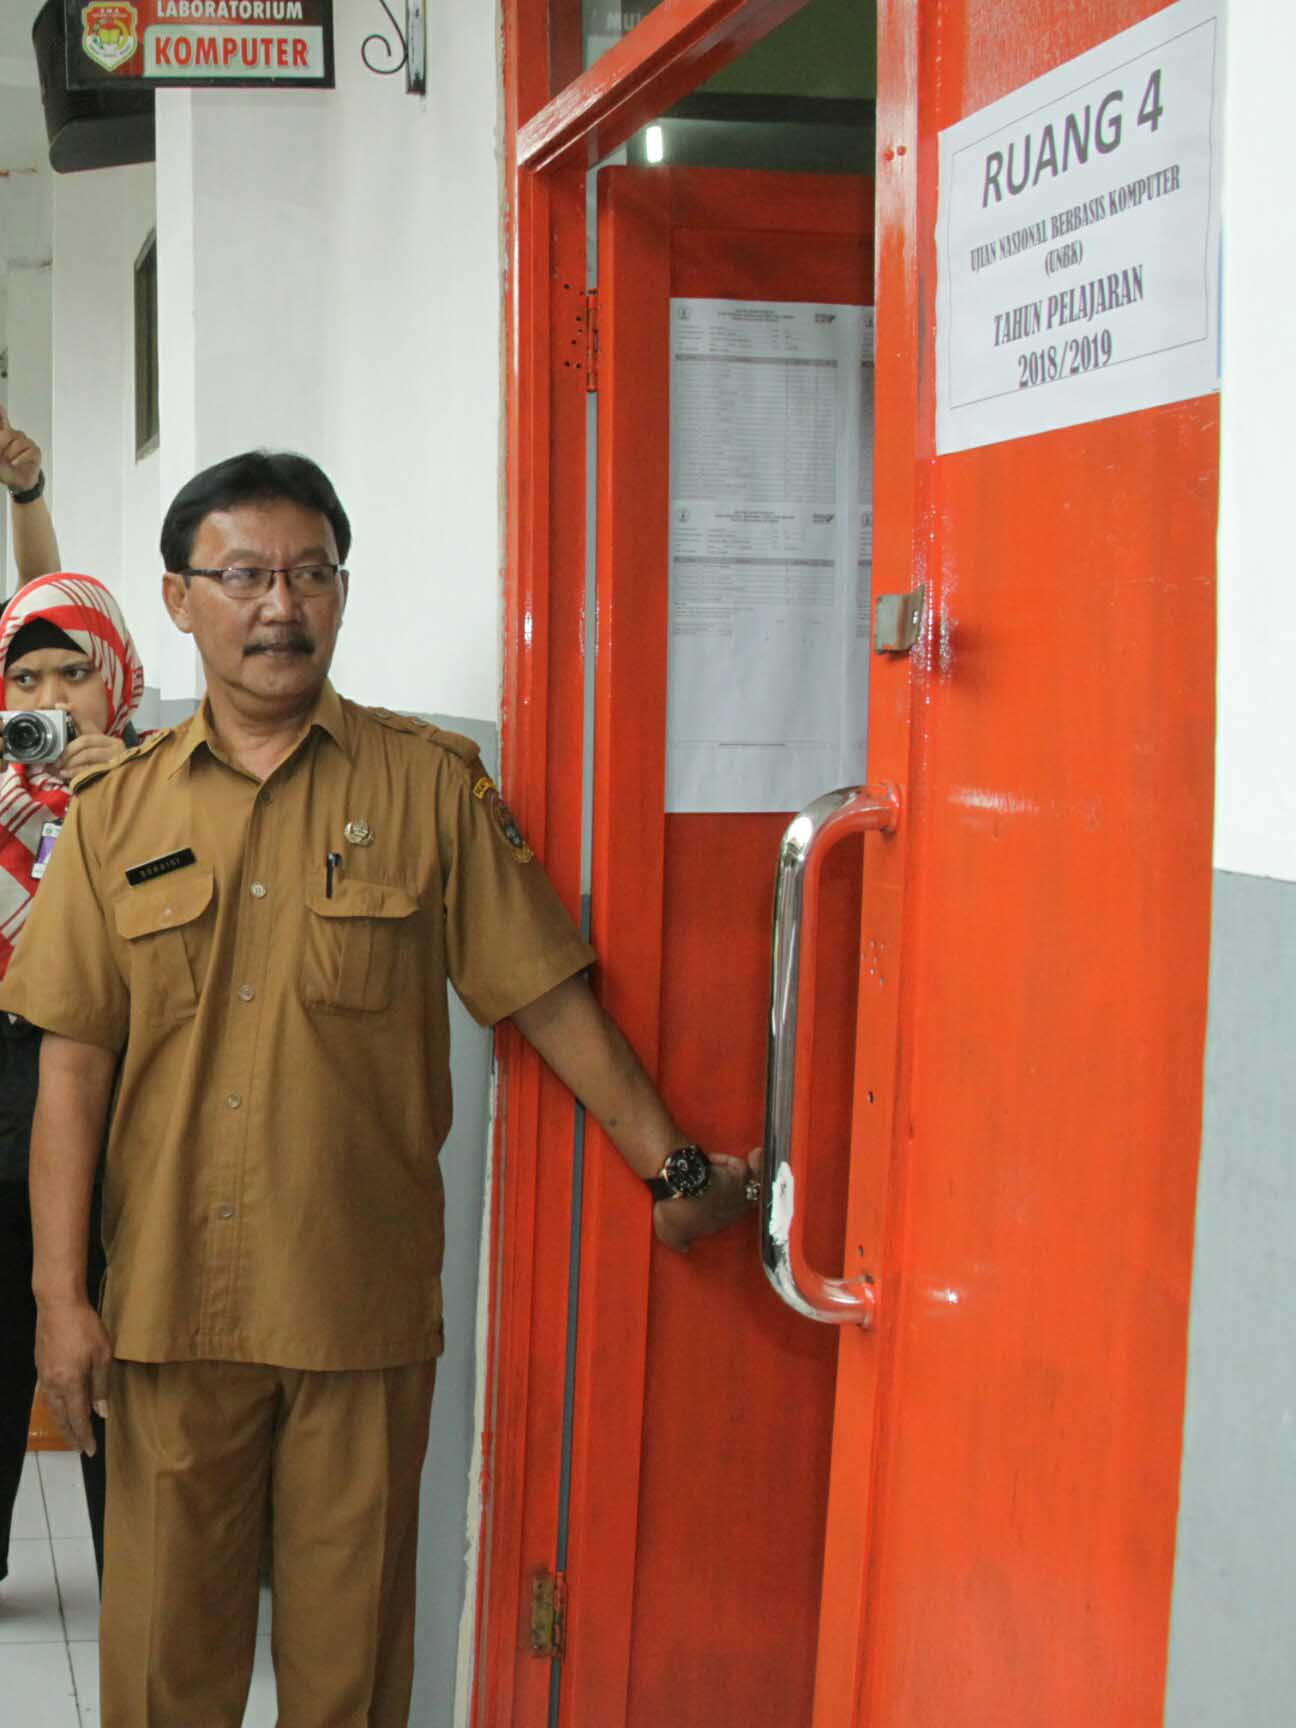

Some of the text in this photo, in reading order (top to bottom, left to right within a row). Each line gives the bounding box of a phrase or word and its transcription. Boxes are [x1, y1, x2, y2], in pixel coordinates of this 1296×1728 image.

[157, 1, 303, 19] LABORATORIUM
[155, 36, 308, 66] KOMPUTER
[982, 68, 1163, 209] RUANG 4
[970, 164, 1180, 272] UJIAN NASIONAL BERBASIS KOMPUTER
[1044, 240, 1084, 277] (UNBK)
[993, 264, 1144, 347] TAHUN PELAJARAN
[1017, 328, 1113, 388] 2018/2019
